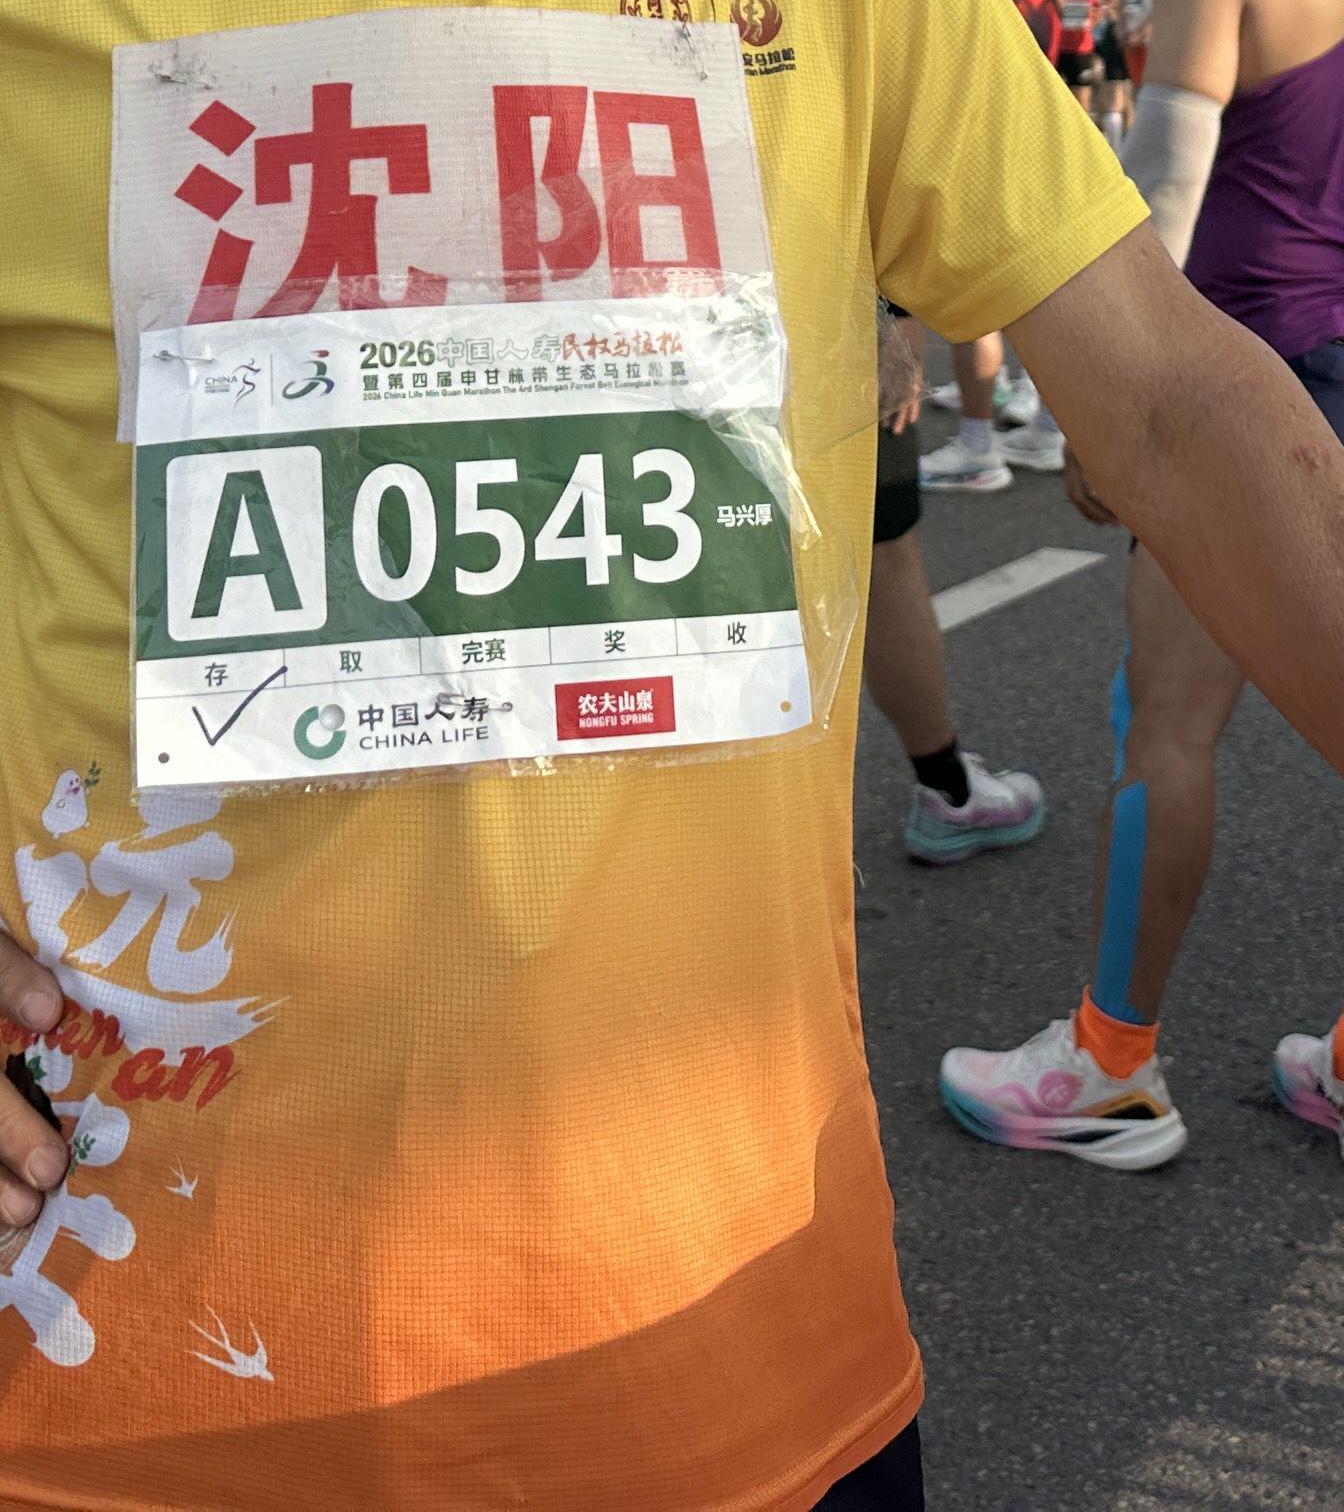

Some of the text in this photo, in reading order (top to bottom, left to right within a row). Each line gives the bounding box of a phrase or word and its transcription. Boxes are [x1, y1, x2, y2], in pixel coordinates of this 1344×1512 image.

[174, 82, 726, 326] 沈阳
[359, 330, 684, 370] 2026中国人寿民权马拉松
[205, 375, 238, 387] CHINA
[384, 390, 406, 400] China
[353, 448, 703, 602] 0543
[717, 503, 773, 527] 马兴厚
[191, 470, 303, 618] A
[205, 621, 747, 687] 存 取 完赛 奖 收
[357, 696, 490, 732] 中国人寿
[578, 689, 654, 716] 农夫山泉
[620, 713, 654, 726] SPRING
[359, 725, 489, 751] CHINA LIFE
